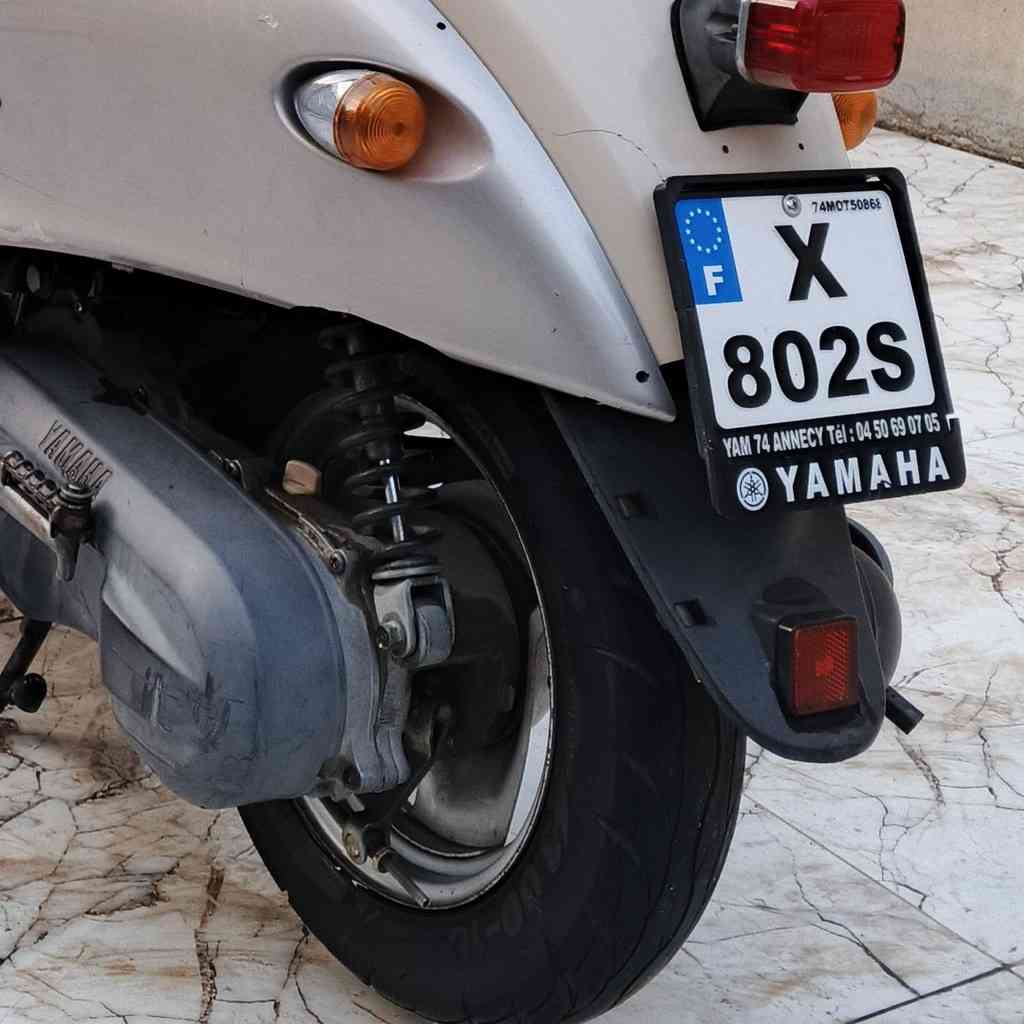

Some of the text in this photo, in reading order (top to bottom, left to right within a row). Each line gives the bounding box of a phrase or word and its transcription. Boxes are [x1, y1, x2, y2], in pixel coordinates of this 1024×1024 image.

[703, 264, 725, 296] F
[774, 222, 848, 302] X
[723, 321, 916, 409] 802S
[38, 419, 113, 496] YAMAHA
[723, 435, 752, 458] YAM
[753, 433, 771, 454] 74
[772, 426, 825, 452] ANNECY
[855, 420, 873, 441] 04
[874, 418, 890, 439] 50
[890, 416, 907, 437] 69
[908, 414, 923, 435] 07
[925, 412, 941, 433] 05
[776, 446, 951, 504] YAMAHA
